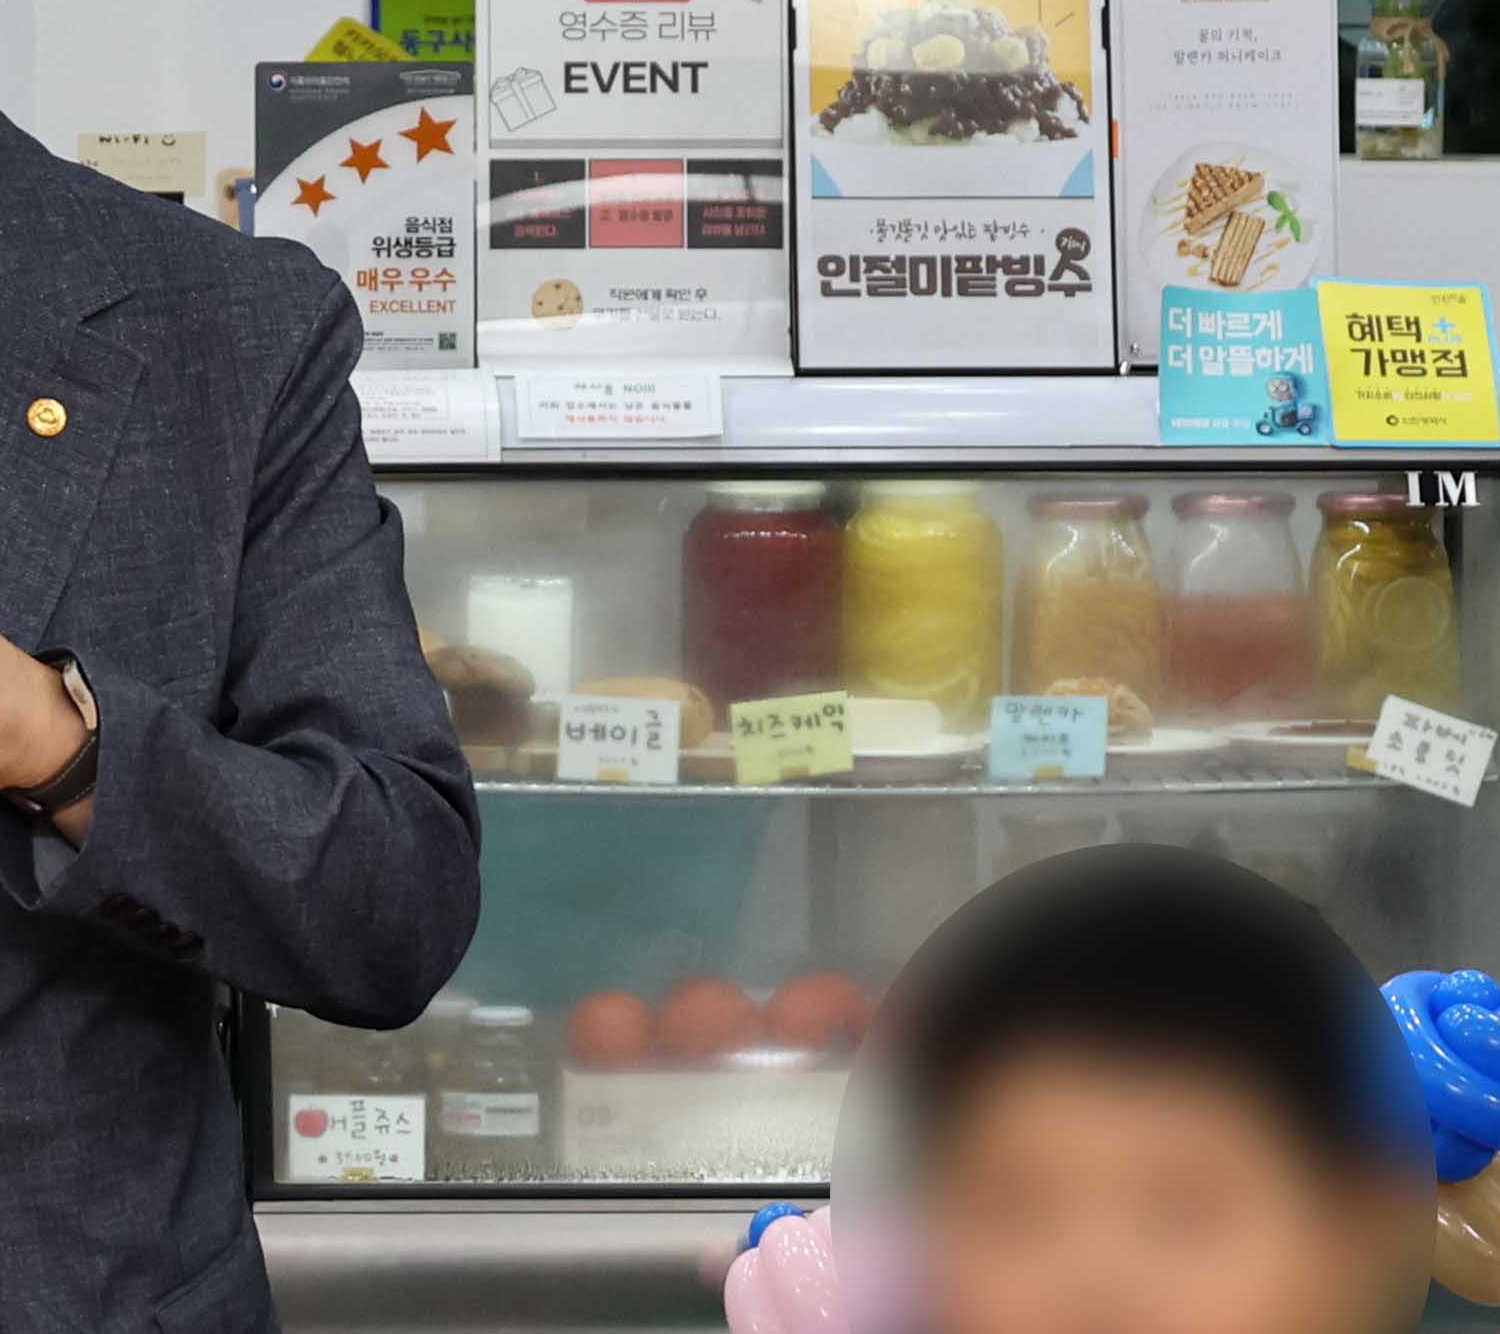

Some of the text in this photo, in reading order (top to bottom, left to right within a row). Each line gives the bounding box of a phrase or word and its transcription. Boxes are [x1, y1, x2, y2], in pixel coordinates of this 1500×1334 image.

[559, 11, 716, 41] 영수증 리뷰
[564, 61, 708, 94] EVENT
[405, 217, 452, 234] 음식점
[371, 236, 456, 259] 위생등급
[817, 227, 1093, 298] 인절미팥빙수
[357, 267, 456, 292] 매우 우수
[369, 299, 457, 314] EXCELLENT
[1168, 306, 1283, 340] 더 빠르게
[1346, 312, 1422, 343] 혜택
[1168, 343, 1314, 378] 더 알뜰하게
[1350, 348, 1468, 378] 가맹점
[565, 709, 662, 751] 베이글
